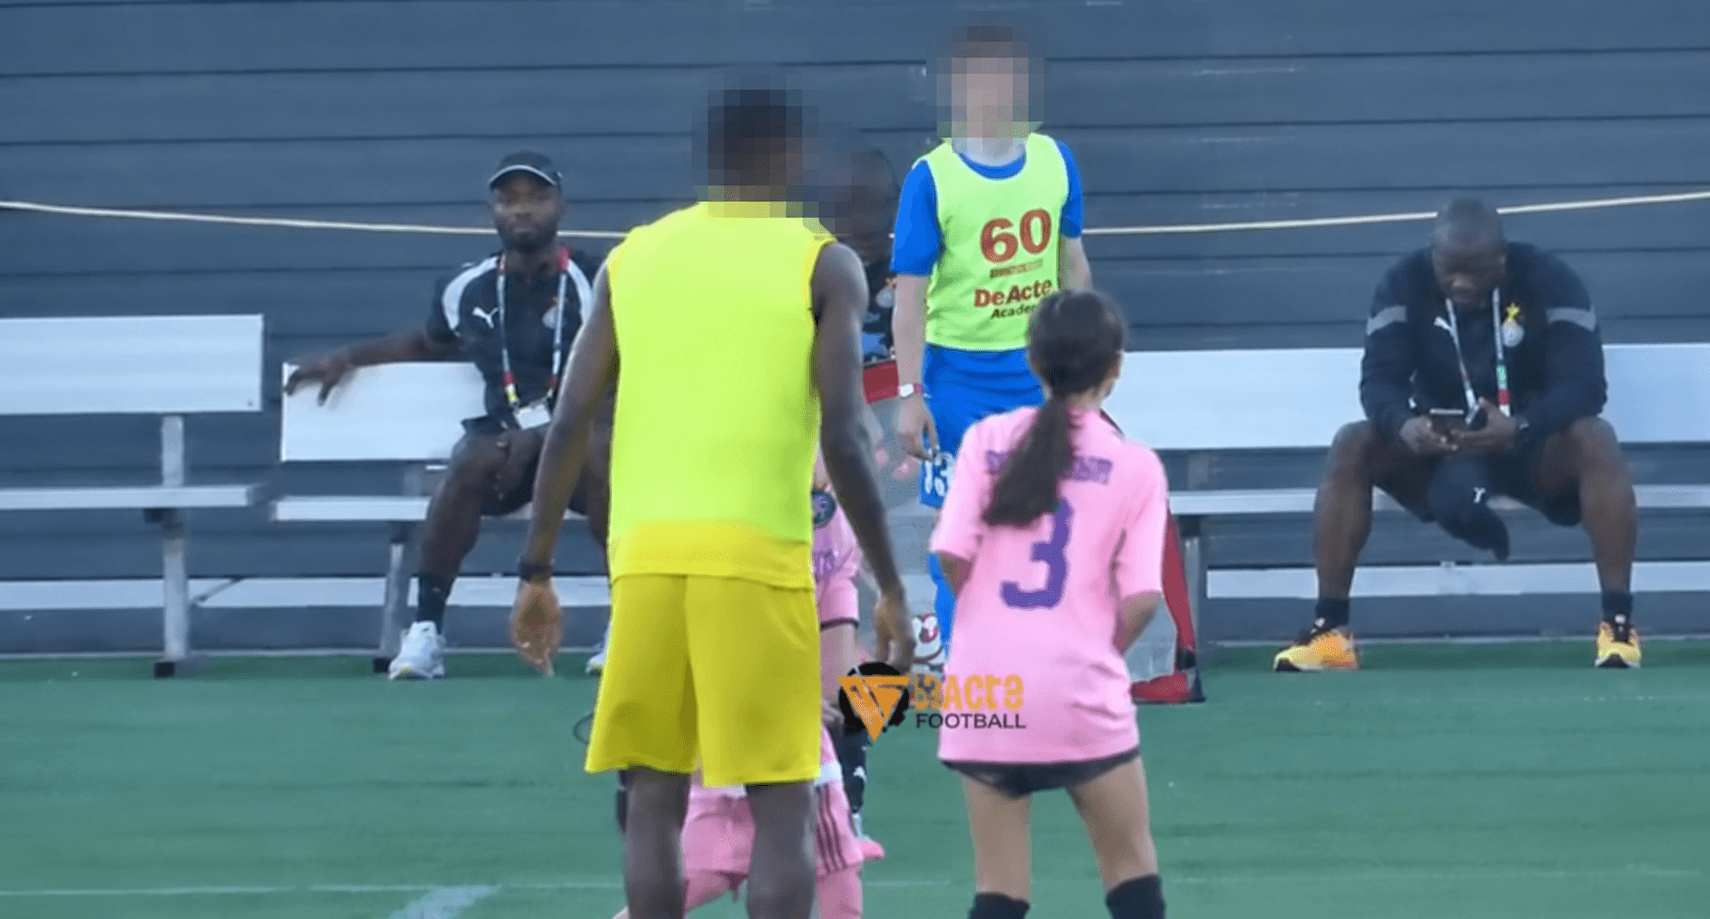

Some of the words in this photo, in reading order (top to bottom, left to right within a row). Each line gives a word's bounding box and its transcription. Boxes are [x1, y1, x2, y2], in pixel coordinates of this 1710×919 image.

[980, 208, 1052, 263] 60
[973, 278, 1052, 308] DeActe
[999, 497, 1074, 610] 3
